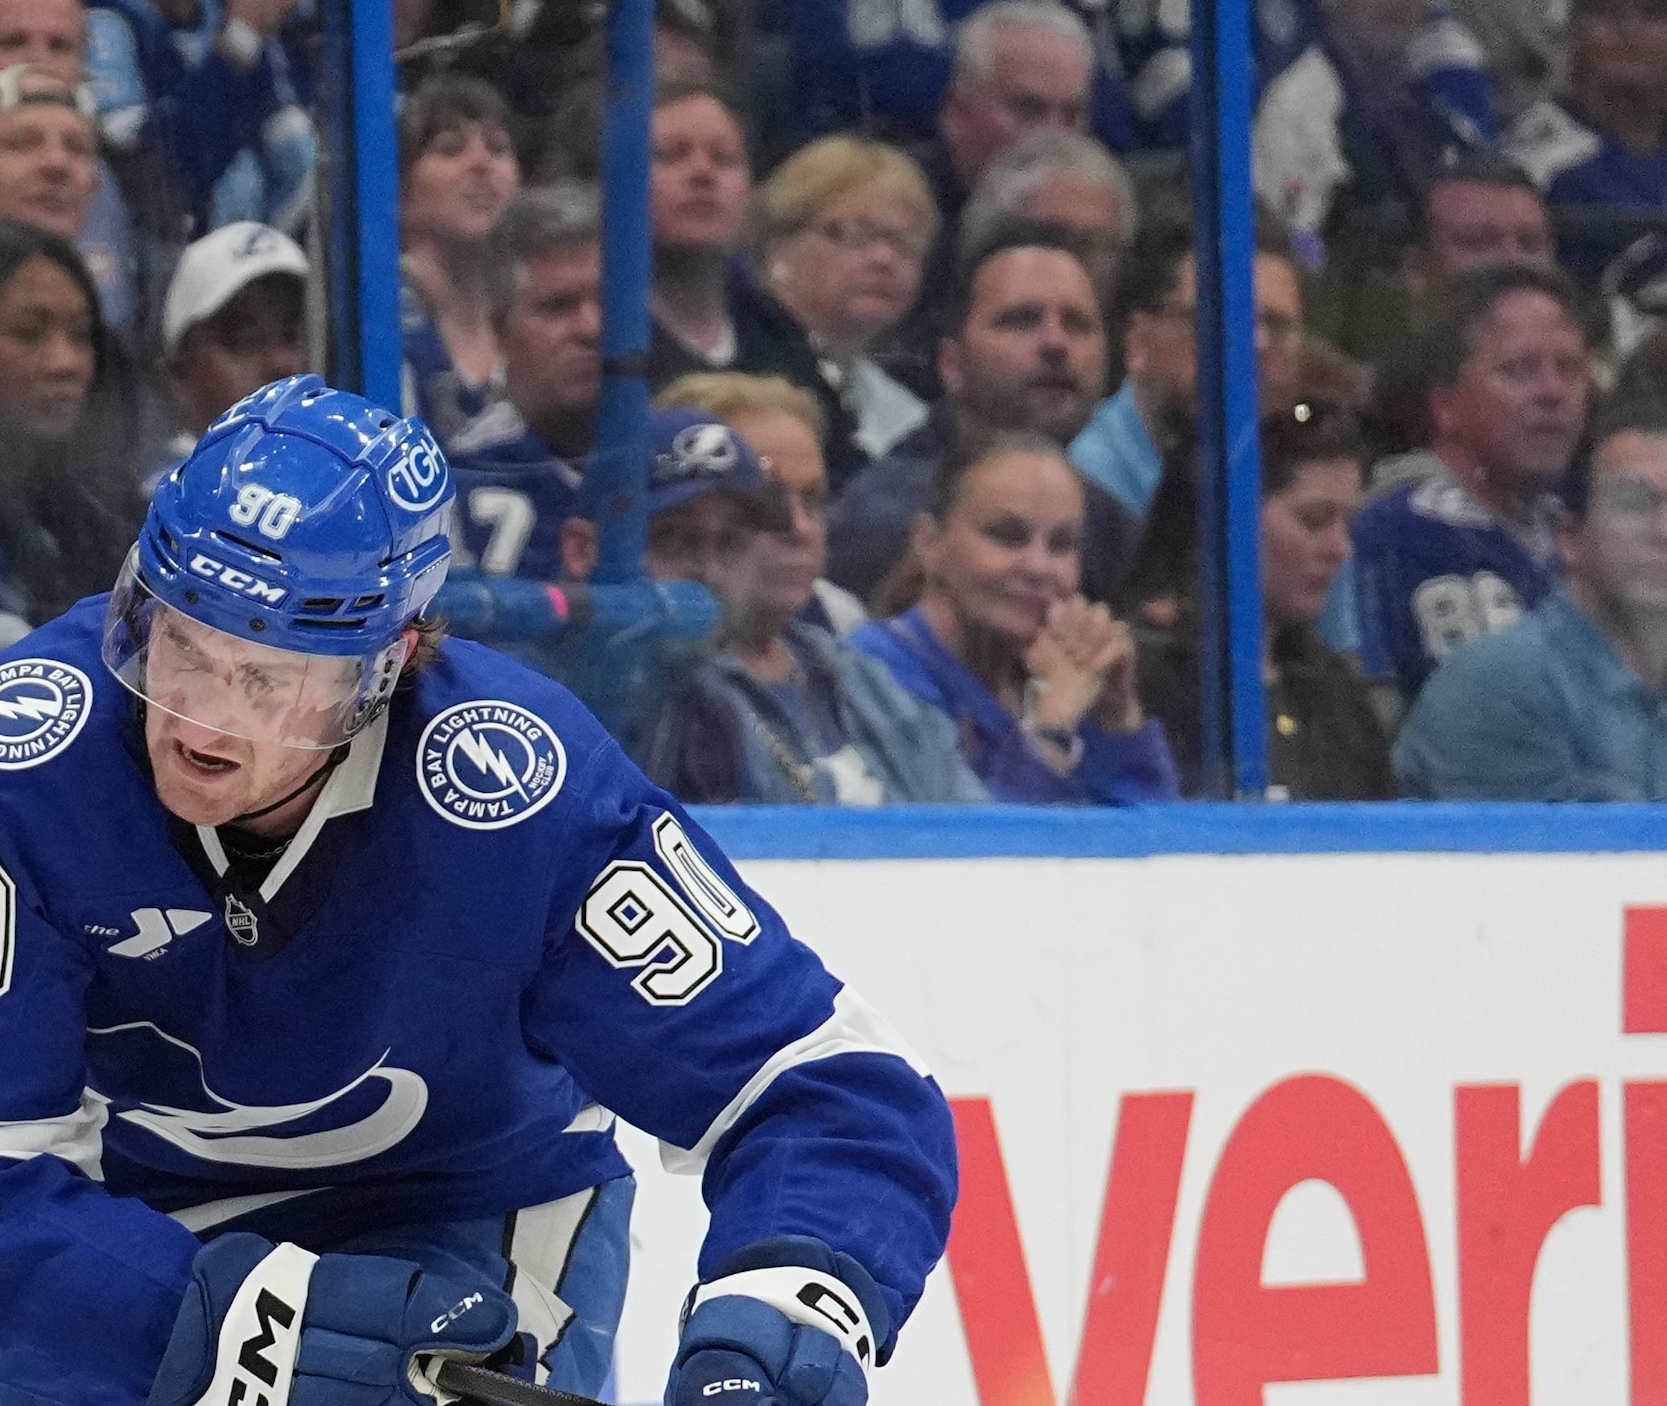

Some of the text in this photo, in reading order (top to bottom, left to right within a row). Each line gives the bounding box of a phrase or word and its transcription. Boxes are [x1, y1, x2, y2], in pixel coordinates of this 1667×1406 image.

[228, 482, 303, 540] 90
[451, 485, 538, 574] 7
[189, 553, 288, 603] CCM
[47, 669, 81, 690] BAY
[427, 707, 543, 818] TAMPA BAY LIGHTNING
[83, 923, 120, 937] the
[574, 810, 763, 1007] 90
[142, 947, 169, 963] YMCA
[430, 1291, 484, 1334] CCM
[702, 1378, 761, 1397] CCM
